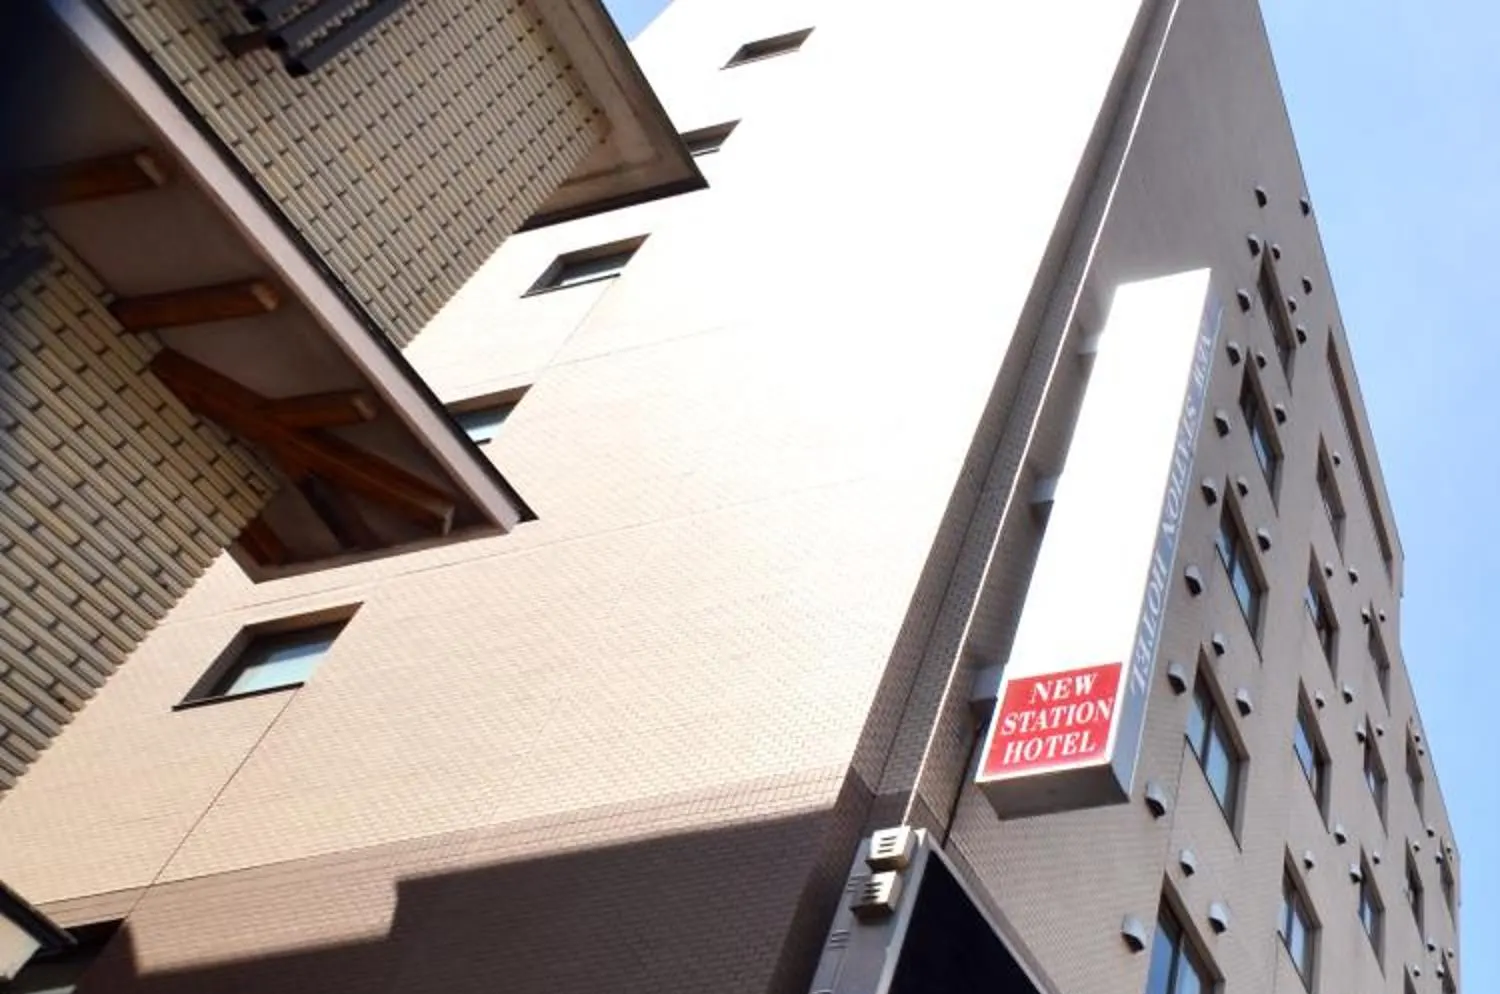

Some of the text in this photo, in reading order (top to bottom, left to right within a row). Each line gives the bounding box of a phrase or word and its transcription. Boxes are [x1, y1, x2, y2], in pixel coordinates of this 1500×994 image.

[1130, 554, 1168, 697] HOTEL
[1029, 672, 1098, 704] NEW
[1001, 697, 1115, 736] STATION
[1003, 729, 1096, 765] HOTEL
